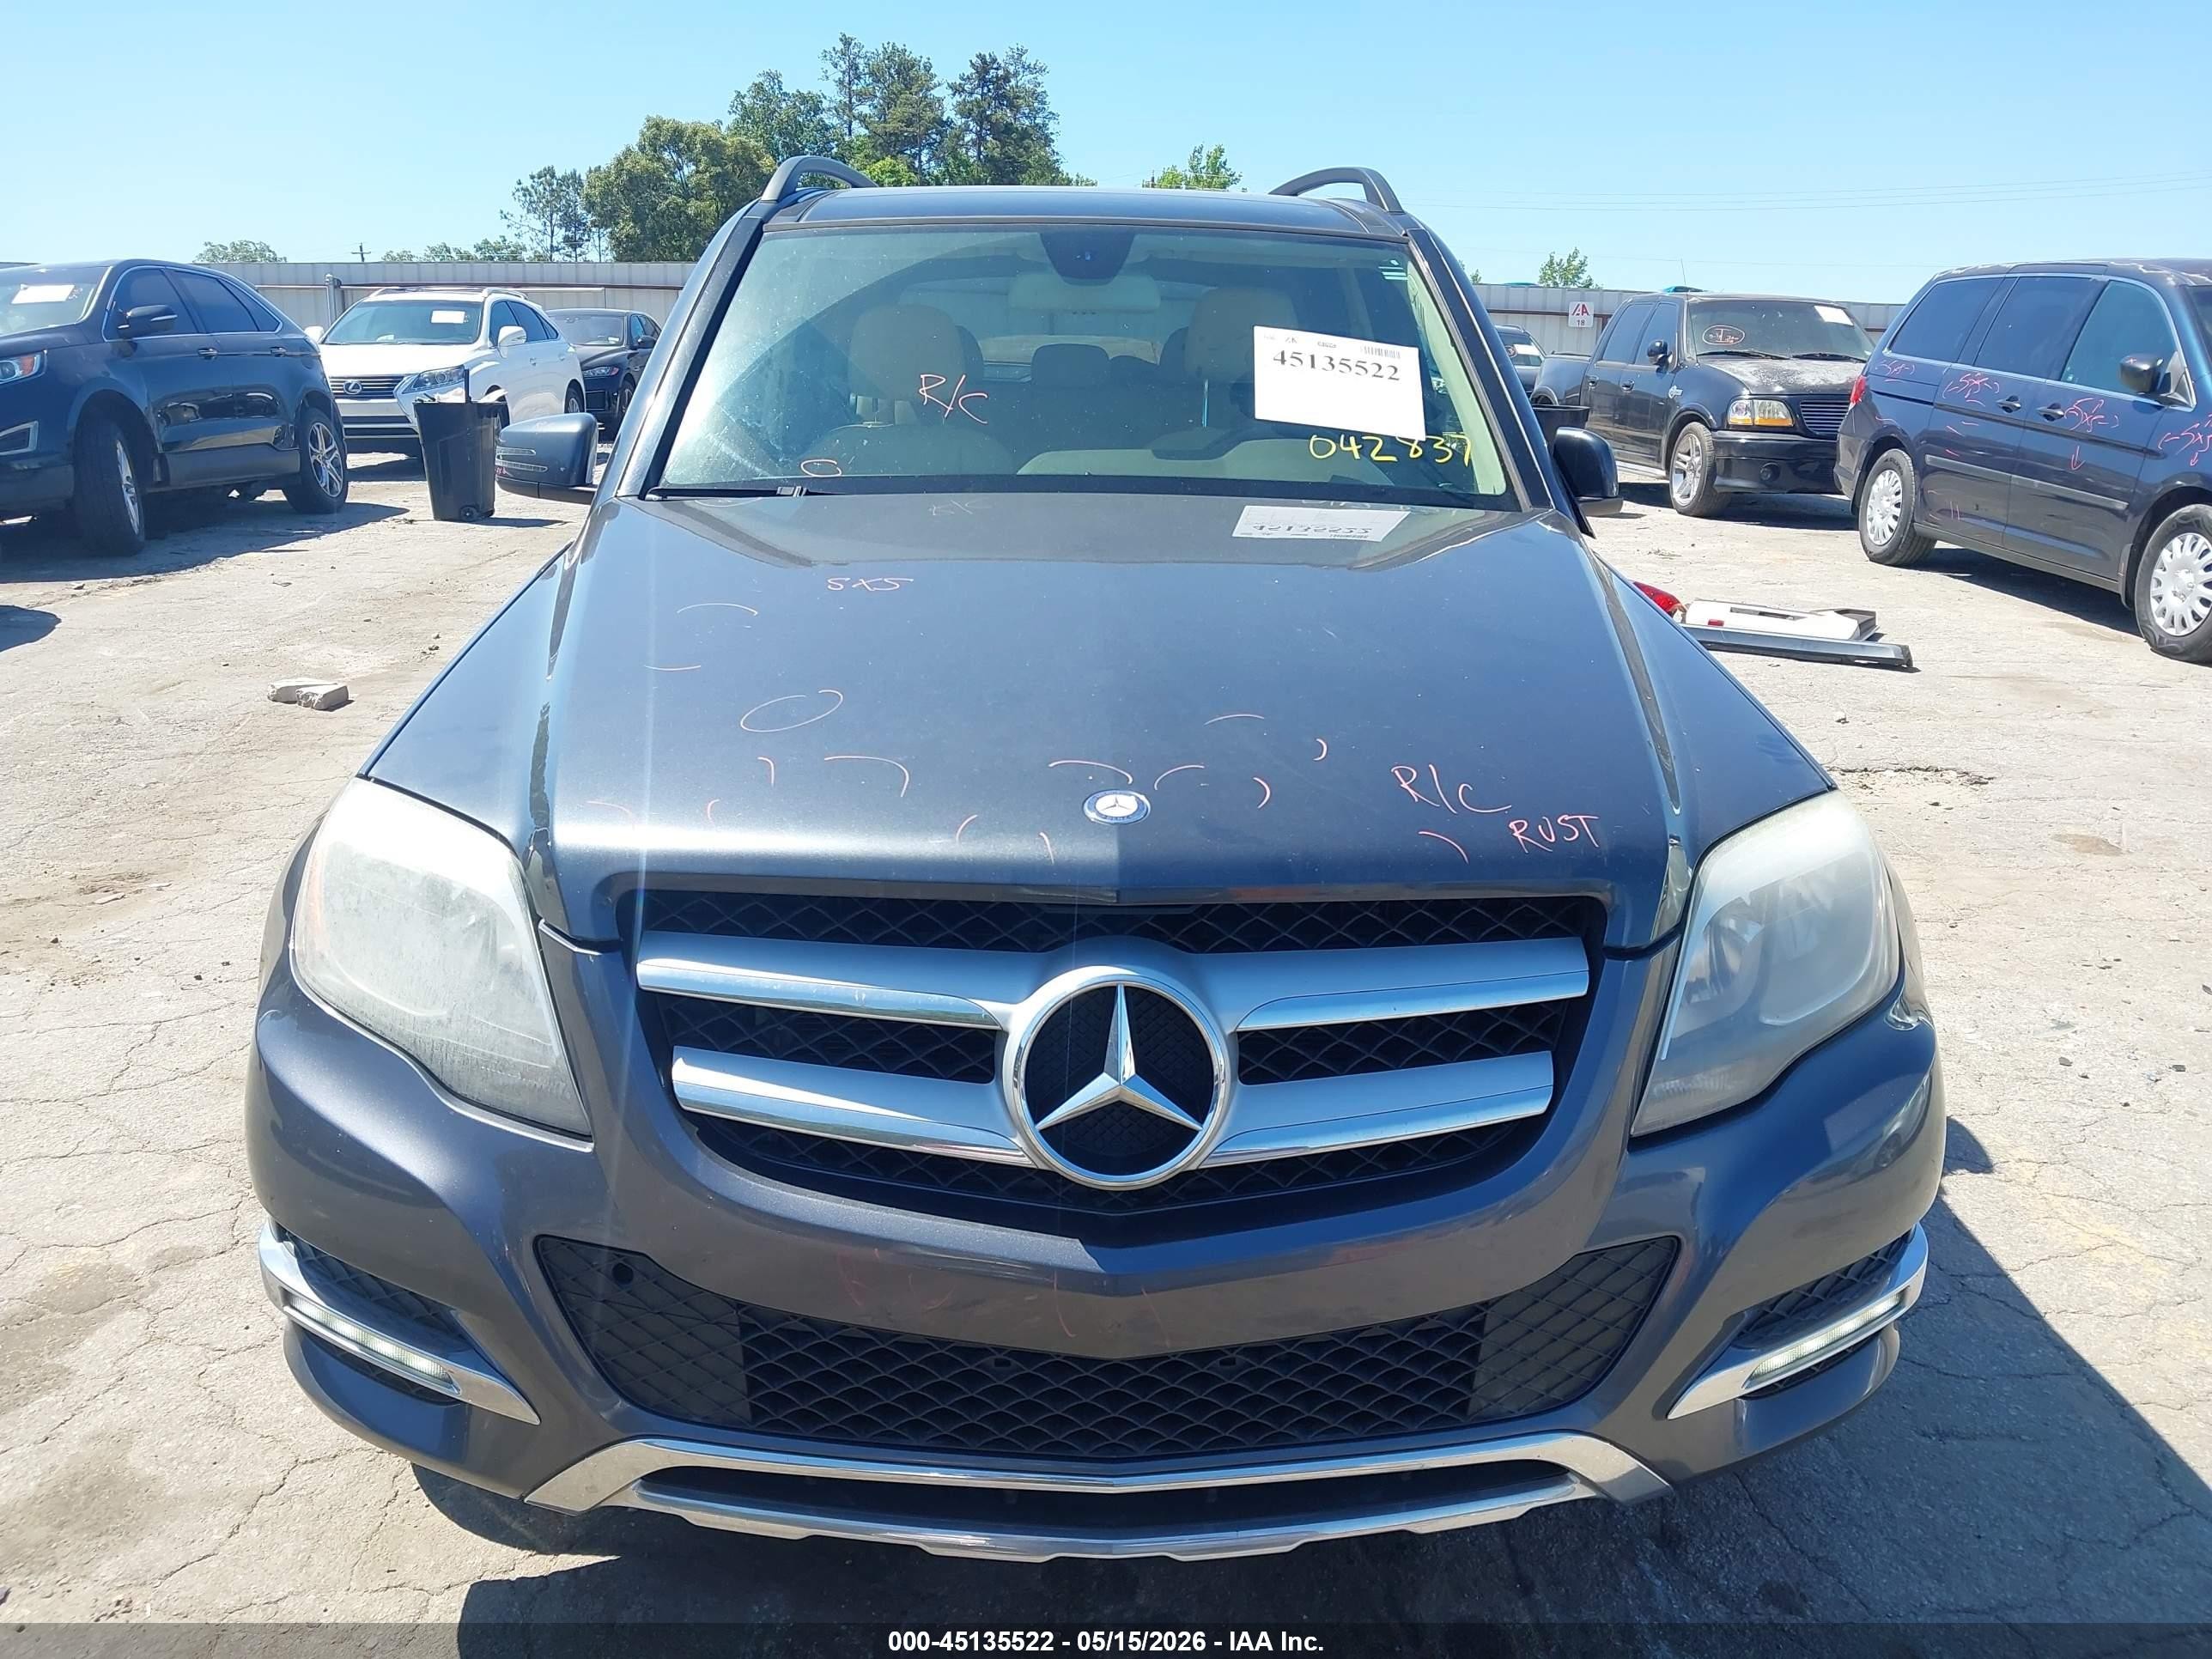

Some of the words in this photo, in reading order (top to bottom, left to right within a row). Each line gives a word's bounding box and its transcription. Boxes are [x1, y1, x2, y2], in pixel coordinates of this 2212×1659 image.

[1273, 349, 1401, 380] 45135522
[1310, 434, 1472, 467] 042837
[1508, 814, 1600, 854] RUST
